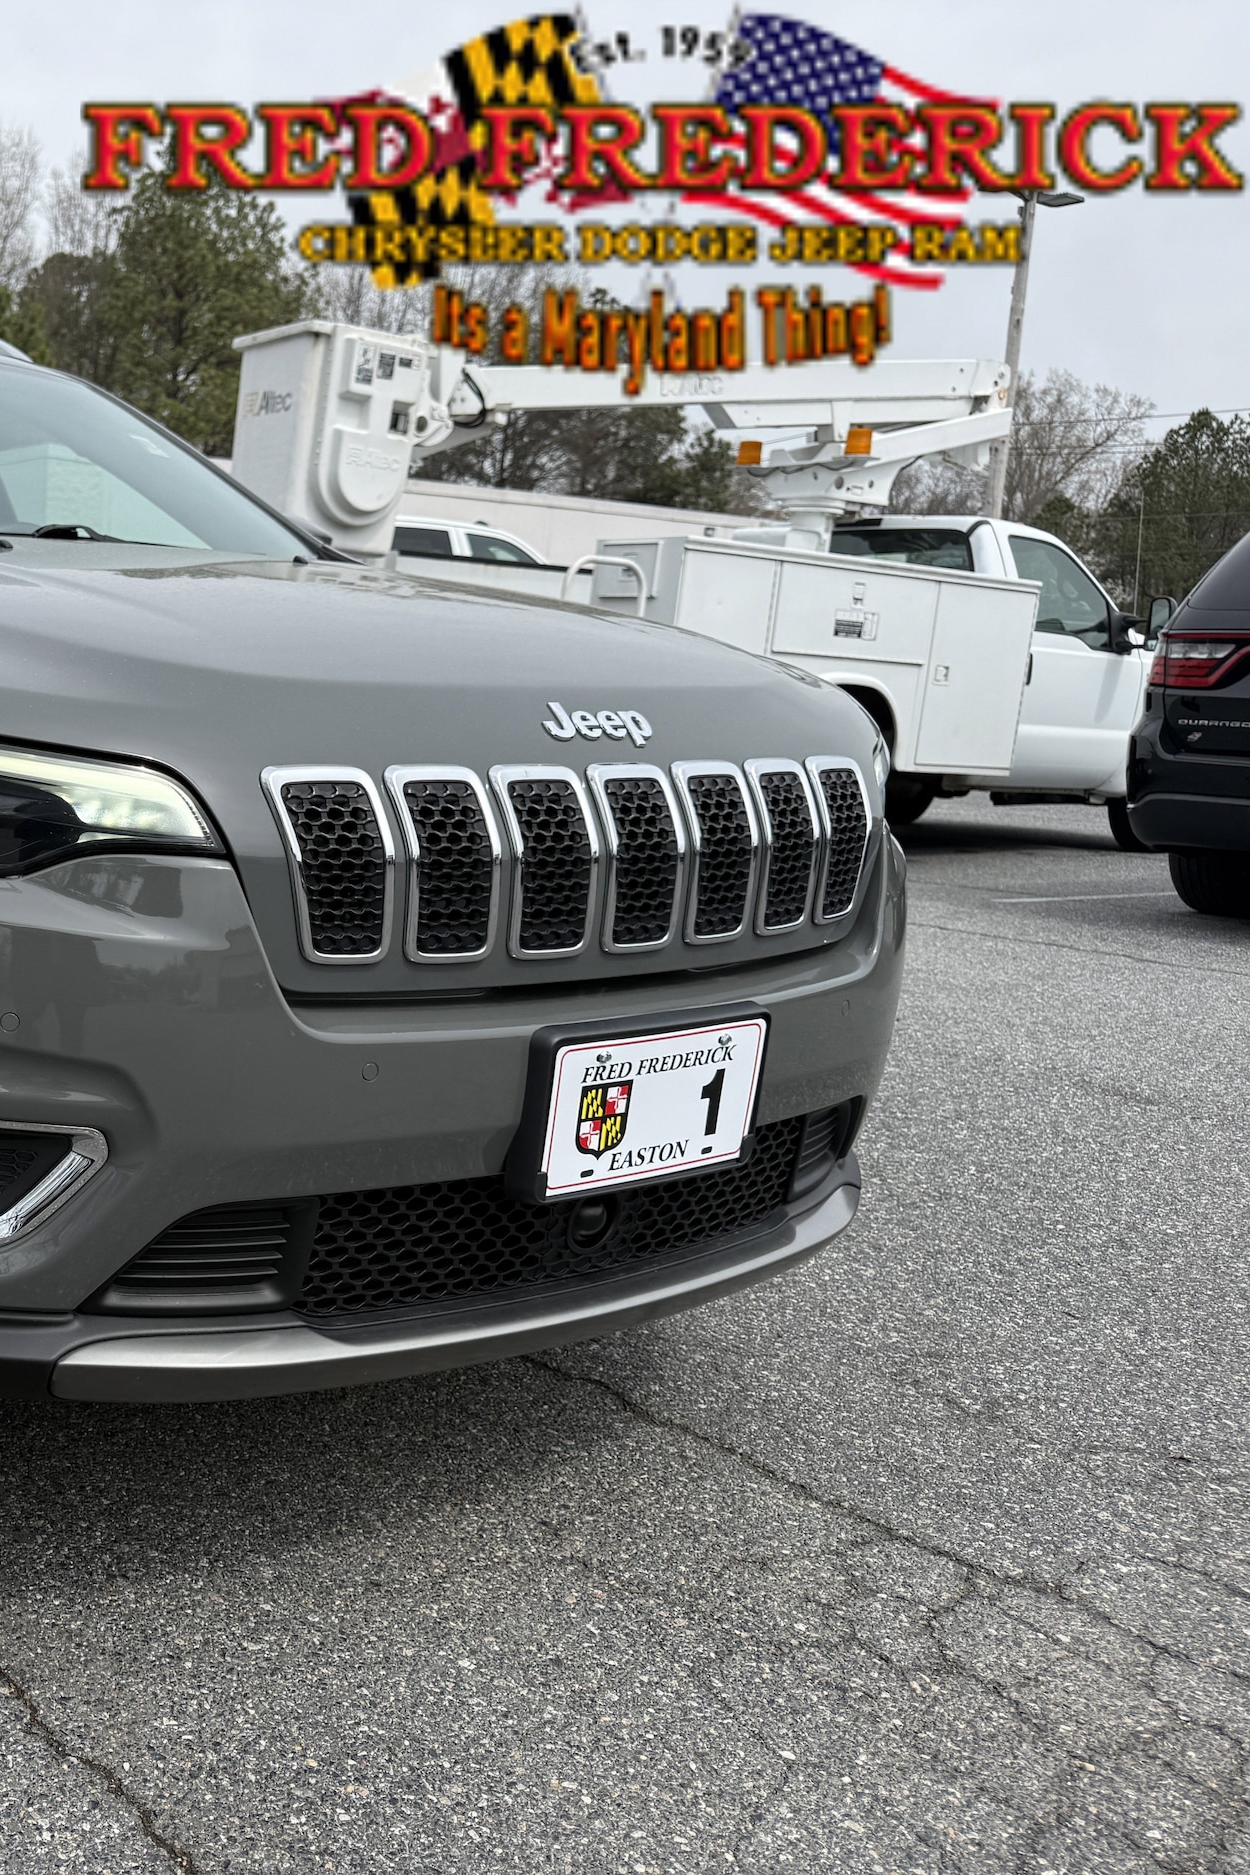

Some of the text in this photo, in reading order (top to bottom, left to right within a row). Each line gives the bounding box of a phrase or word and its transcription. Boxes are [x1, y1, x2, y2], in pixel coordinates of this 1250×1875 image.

[542, 701, 653, 749] Jeep
[1177, 718, 1250, 728] DURANGO
[581, 1044, 737, 1084] FRED FREDERICK
[700, 1068, 726, 1136] 1
[607, 1139, 690, 1172] EASTON
